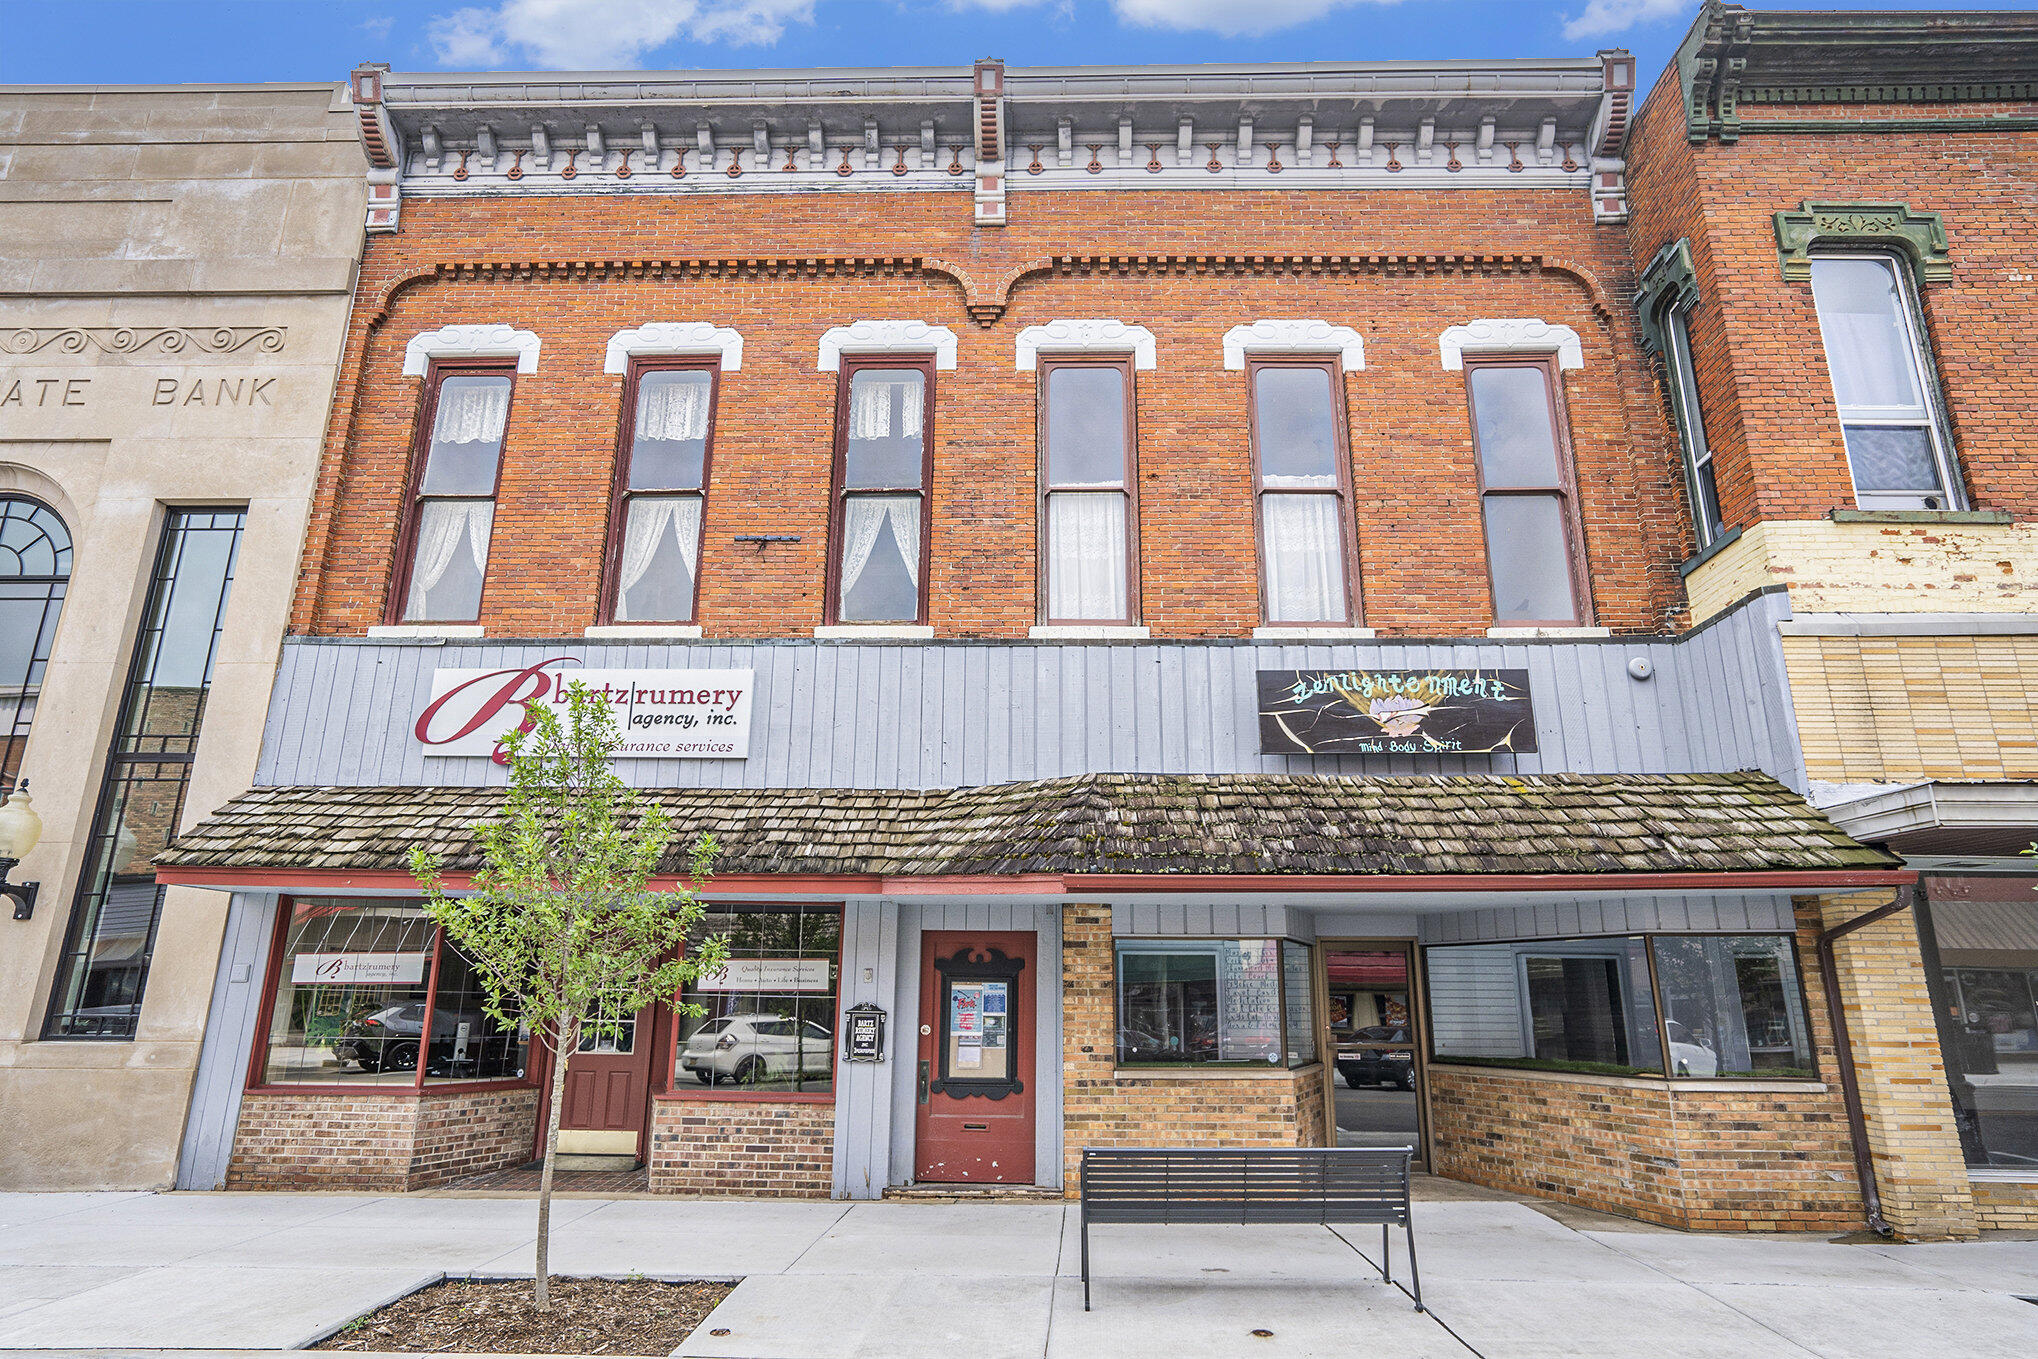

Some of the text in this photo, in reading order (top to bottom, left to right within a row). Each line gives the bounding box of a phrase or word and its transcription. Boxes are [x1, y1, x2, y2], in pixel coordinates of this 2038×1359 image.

[152, 378, 277, 406] BANK
[553, 673, 629, 705] brtz
[632, 709, 738, 730] agency, inc.
[675, 739, 734, 753] services
[1389, 741, 1418, 754] Body
[1423, 737, 1463, 753] Spirit
